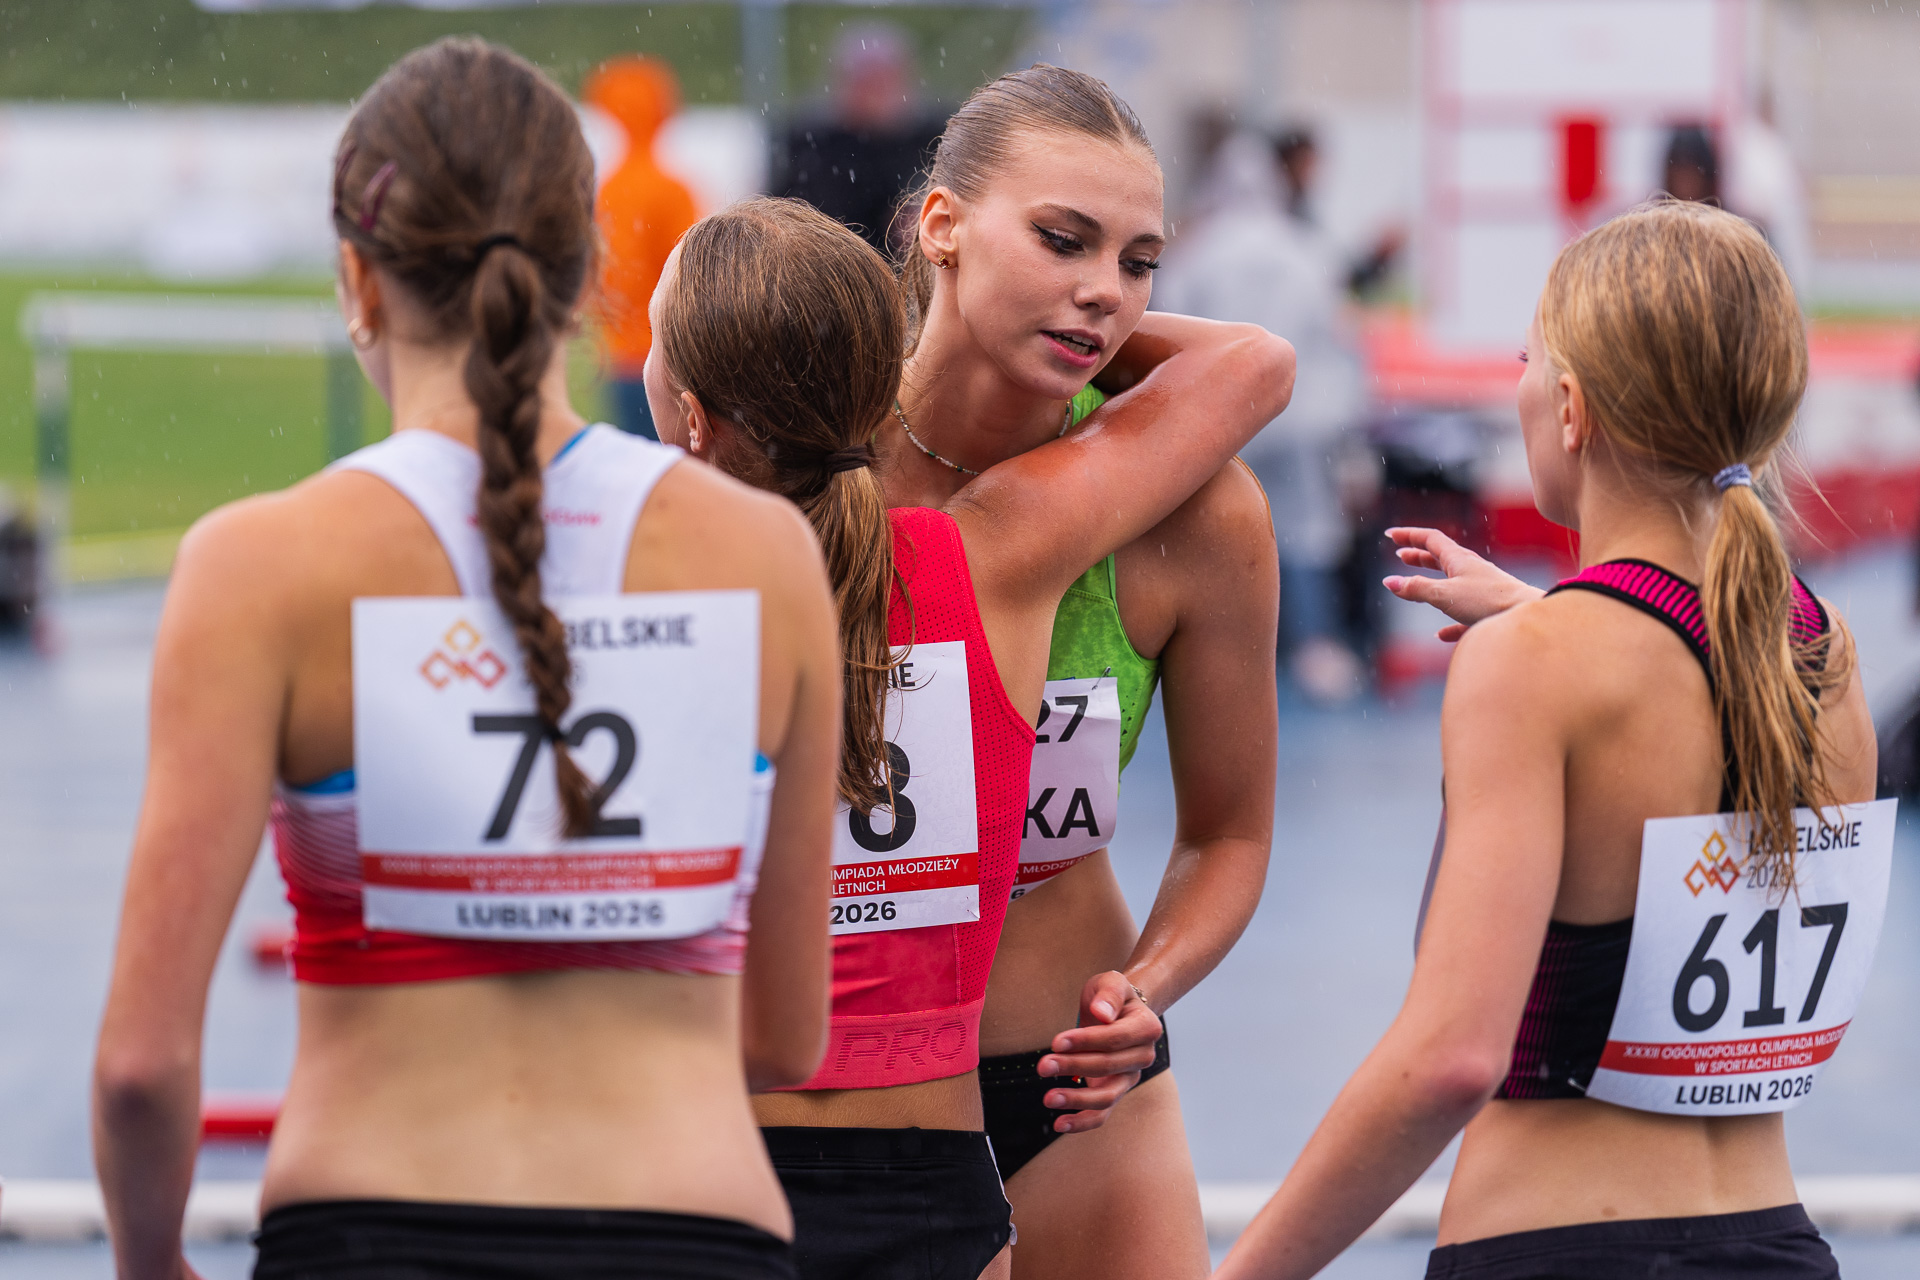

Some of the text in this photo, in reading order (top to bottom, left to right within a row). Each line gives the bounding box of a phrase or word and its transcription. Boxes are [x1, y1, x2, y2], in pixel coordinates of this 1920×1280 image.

[472, 712, 642, 842] 72
[888, 857, 959, 876] MŁODZIEŻY
[832, 880, 886, 895] LETNICH
[457, 901, 665, 928] LUBLIN 2026
[830, 901, 896, 925] 2026
[1672, 902, 1849, 1033] 617
[834, 1020, 967, 1072] PRO
[1661, 1041, 1758, 1060] OGÓLNOPOLSKA
[1760, 1035, 1813, 1054] OLIMPIADA
[1694, 1052, 1813, 1074] W SPORTACH LETNICH
[1675, 1074, 1813, 1105] LUBLIN 2026
